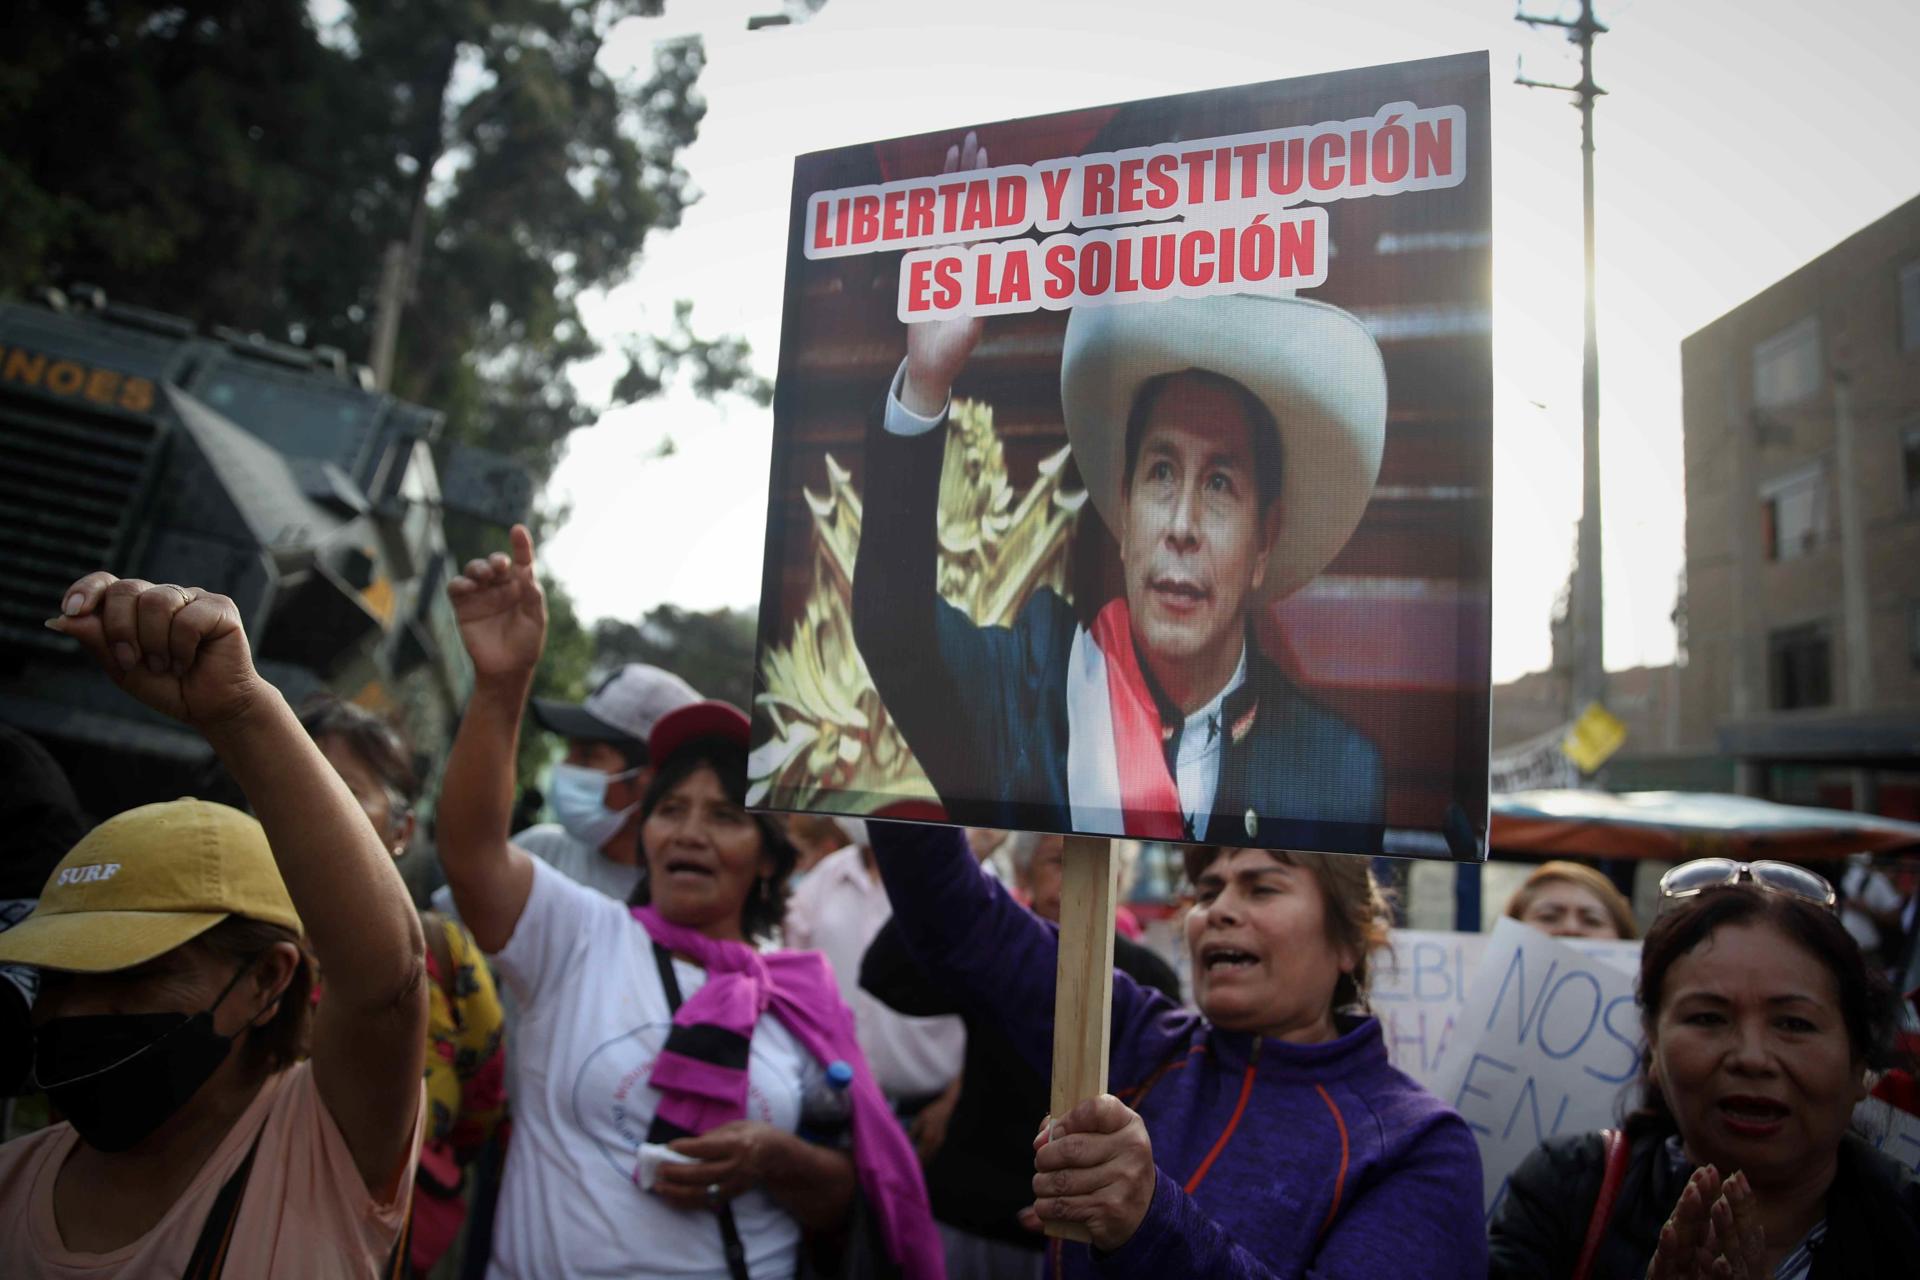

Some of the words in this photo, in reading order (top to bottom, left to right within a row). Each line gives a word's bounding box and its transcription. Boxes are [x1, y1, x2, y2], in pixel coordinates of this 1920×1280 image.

[814, 175, 1027, 249] LIBERTAD
[1040, 168, 1072, 221] Y
[1082, 113, 1454, 217] RESTITUCIÓN
[907, 257, 963, 312] ES
[974, 250, 1032, 305] LA
[1044, 214, 1316, 299] SOLUCIÓN
[0, 343, 155, 412] NOES
[57, 863, 122, 886] SURF
[1486, 945, 1642, 1084] NOS
